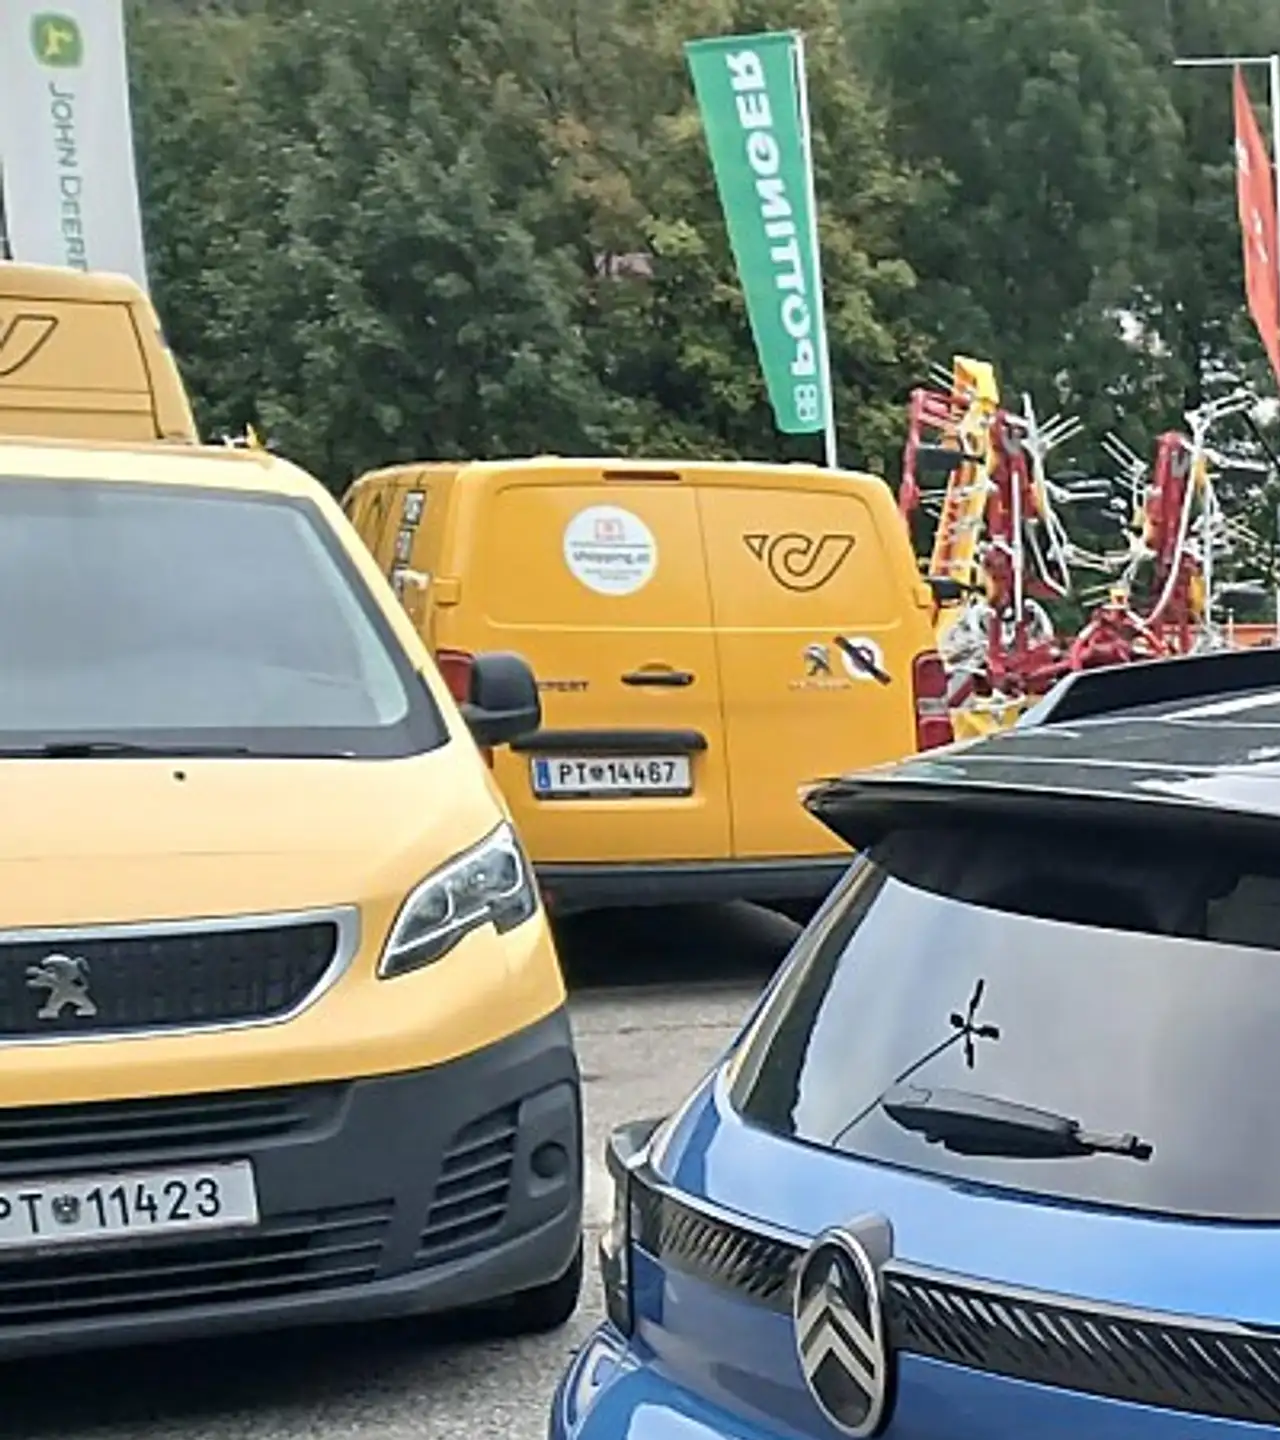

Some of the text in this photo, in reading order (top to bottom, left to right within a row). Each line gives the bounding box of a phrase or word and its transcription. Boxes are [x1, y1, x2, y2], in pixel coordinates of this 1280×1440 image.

[49, 81, 78, 168] JOHN
[559, 762, 588, 785] PT
[86, 1177, 220, 1227] 11423
